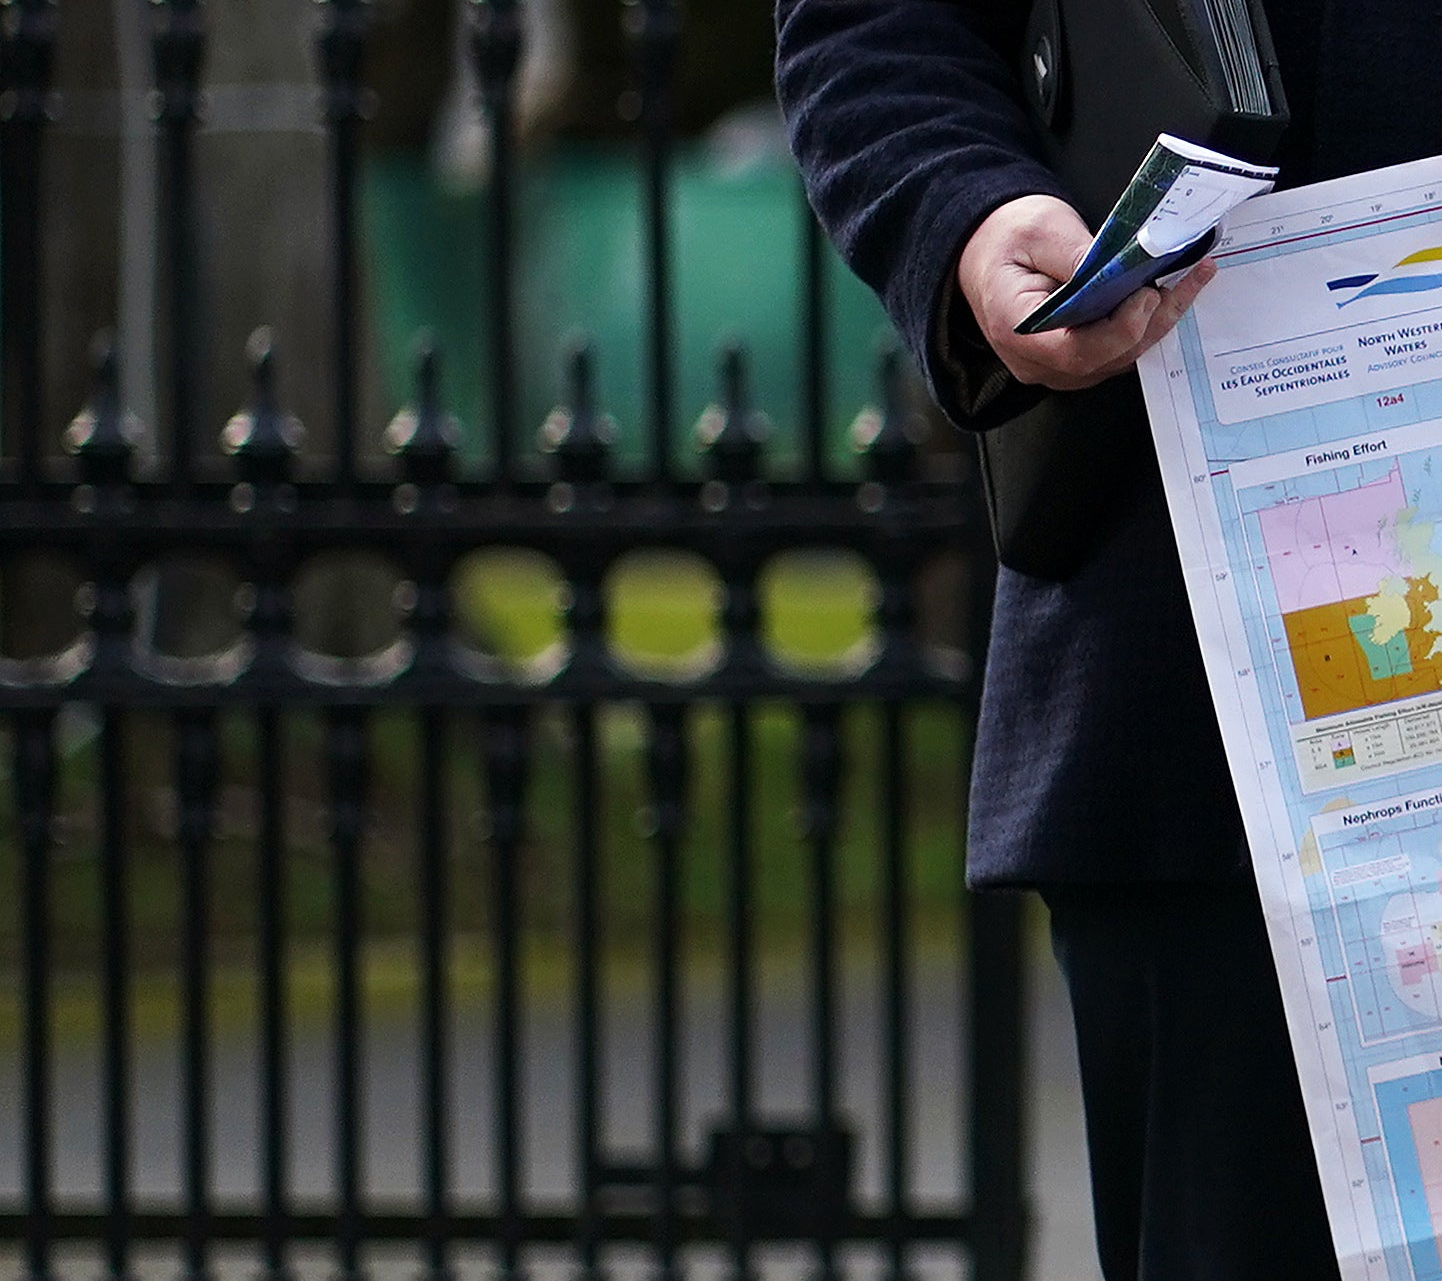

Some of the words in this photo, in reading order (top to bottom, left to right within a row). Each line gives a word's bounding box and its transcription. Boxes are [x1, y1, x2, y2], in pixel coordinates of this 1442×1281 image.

[1358, 333, 1395, 347] NORTH
[1384, 340, 1427, 356] WATERS
[1240, 373, 1269, 386] EAUX
[1272, 356, 1347, 379] OCCIDENTALES
[1255, 369, 1350, 397] SEPTENTRIONALES
[1377, 394, 1404, 407] 12a4
[1306, 450, 1349, 466] Fishing
[1353, 440, 1387, 455] Effort
[1343, 806, 1402, 826] Nephrops
